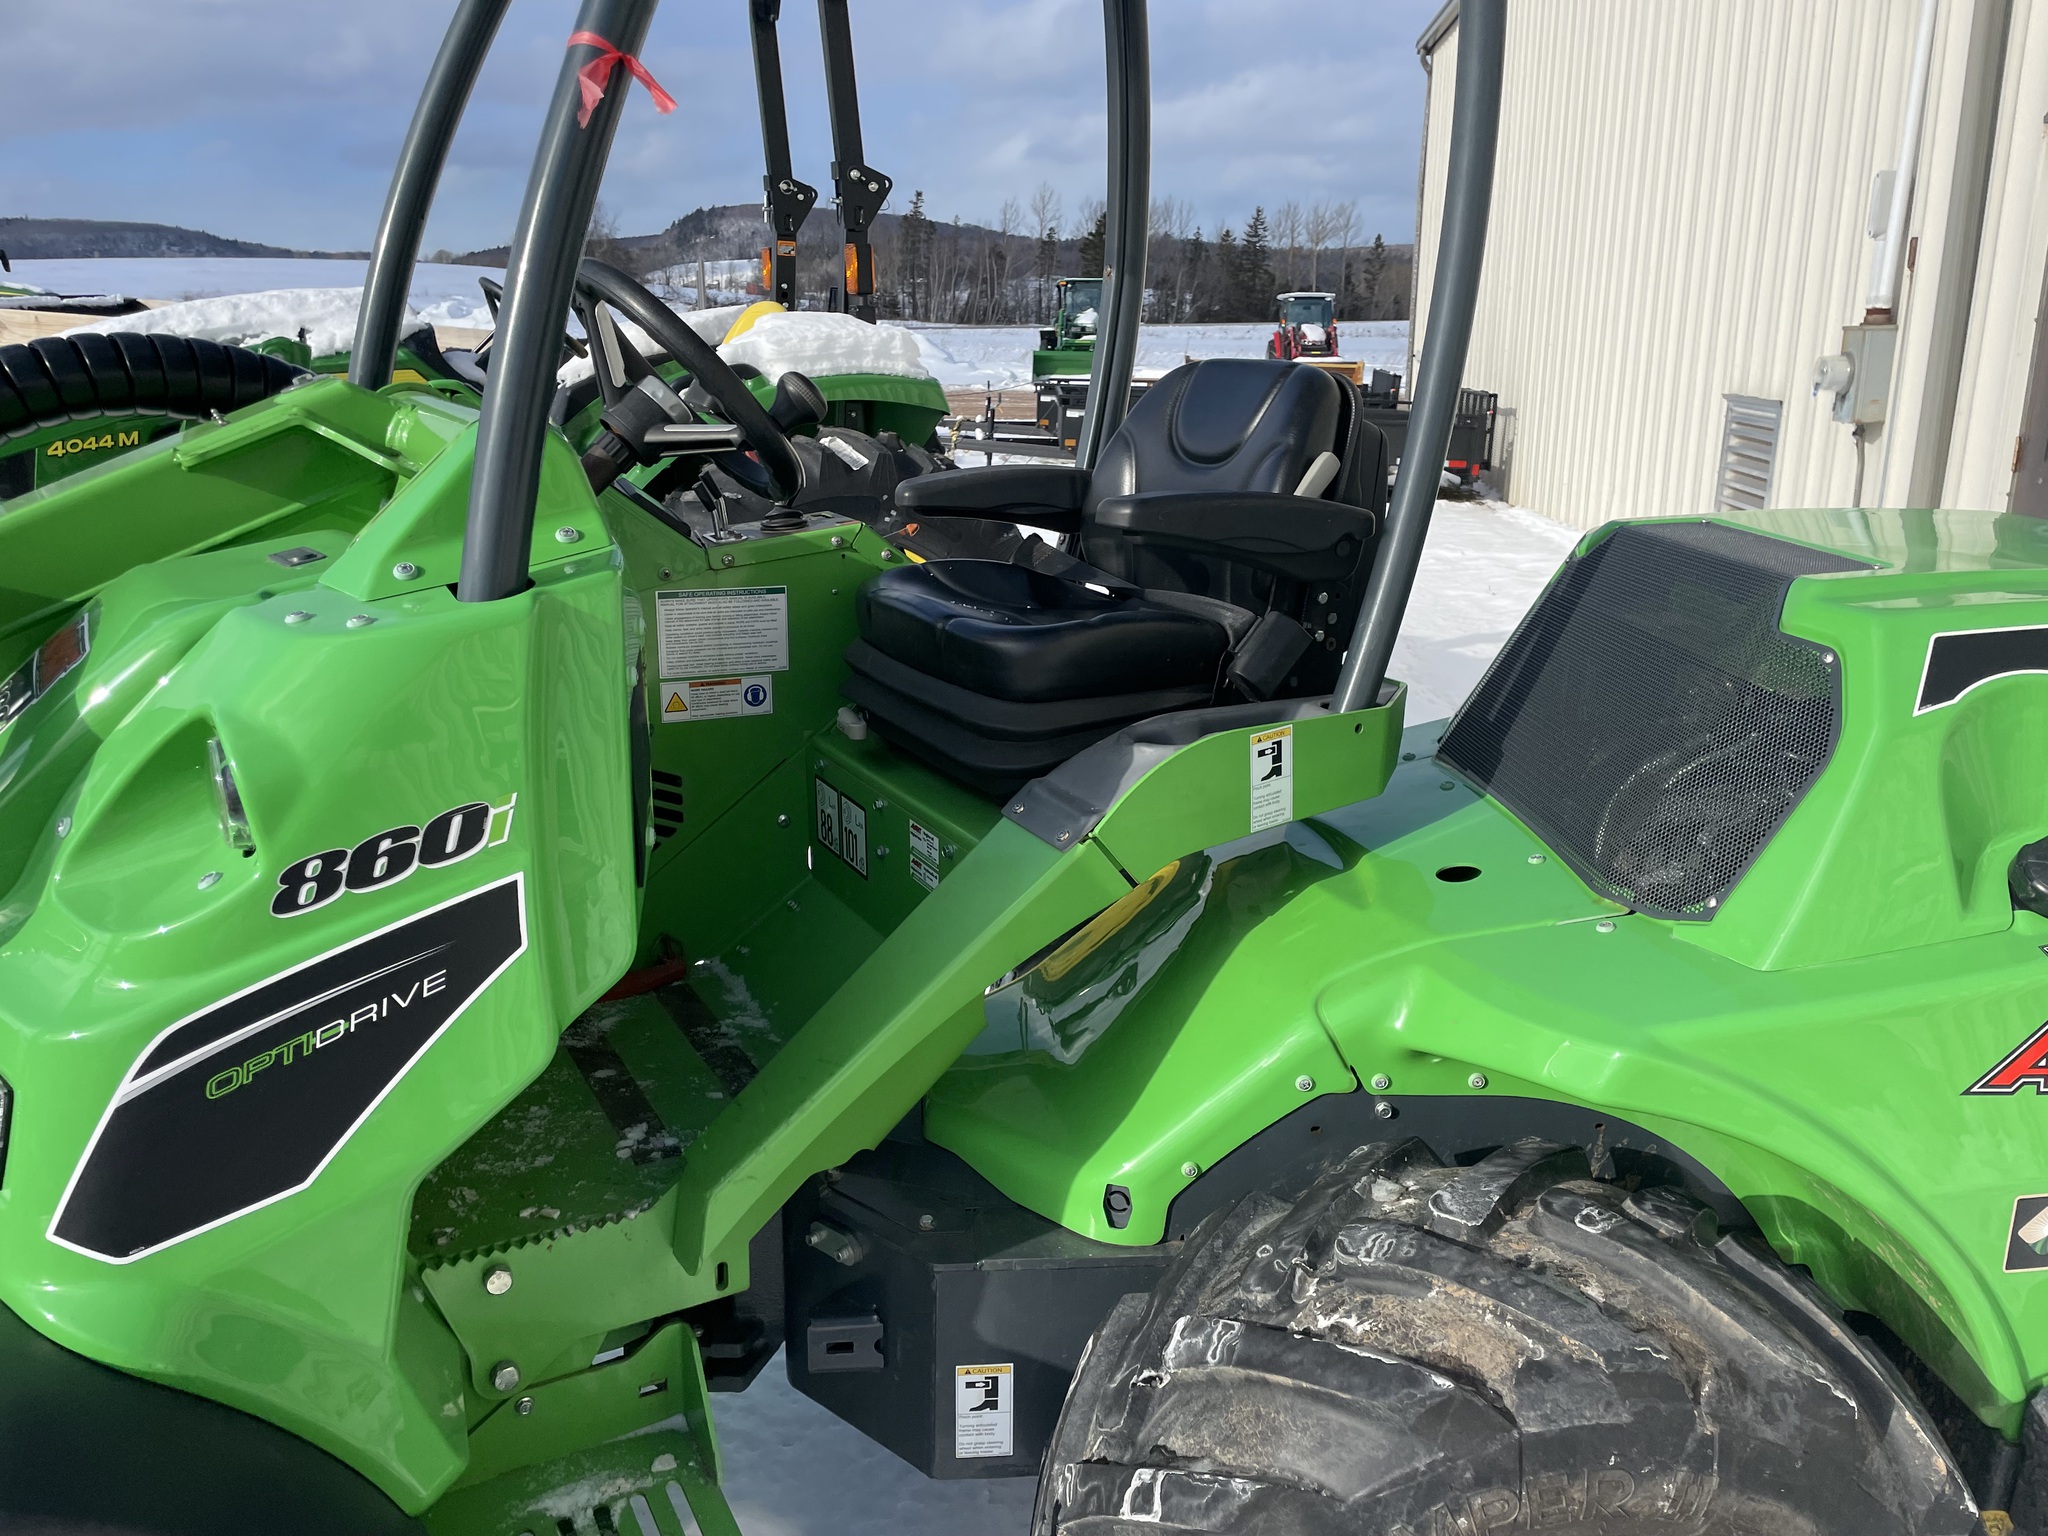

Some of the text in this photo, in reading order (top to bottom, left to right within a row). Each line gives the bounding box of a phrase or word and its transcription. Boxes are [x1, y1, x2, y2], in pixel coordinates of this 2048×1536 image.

[1263, 731, 1285, 740] CAUTION
[820, 808, 834, 847] 88
[844, 826, 858, 867] 101
[270, 792, 517, 919] 860i
[205, 968, 449, 1101] OPTIDRIVE
